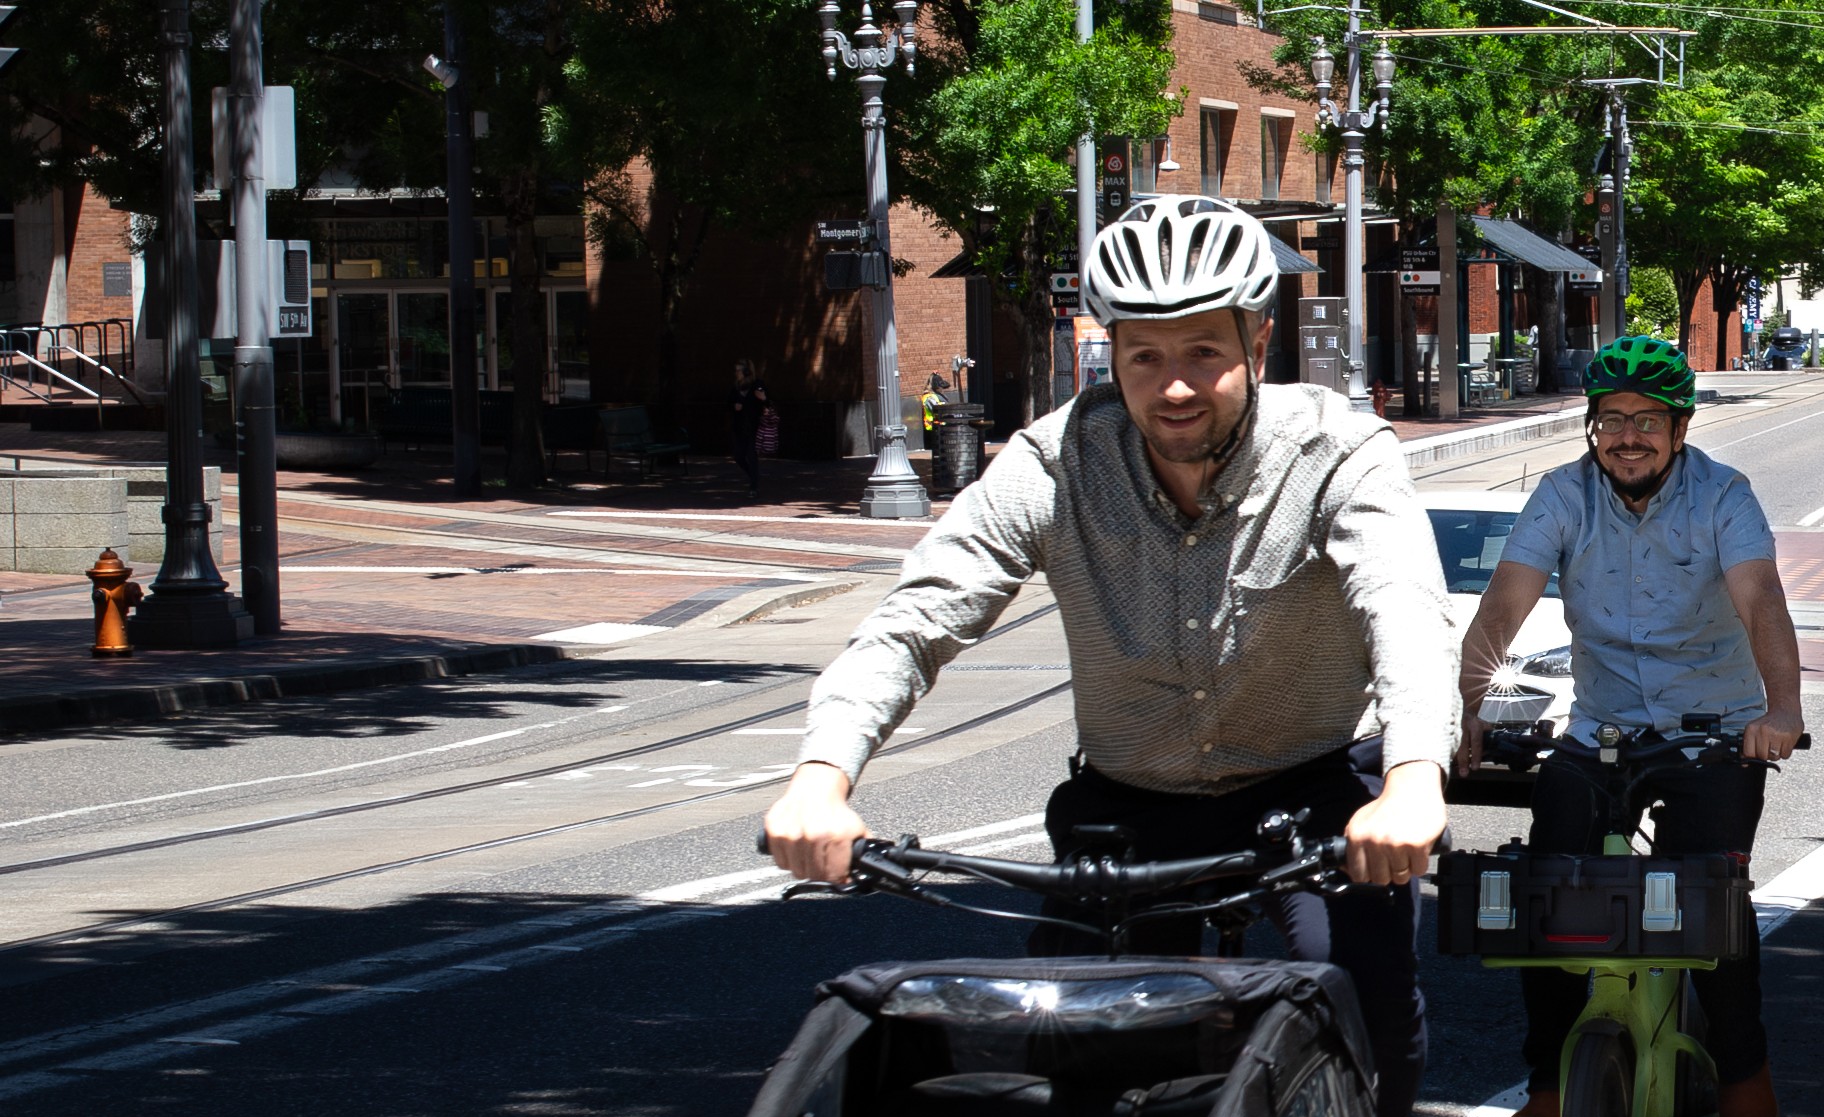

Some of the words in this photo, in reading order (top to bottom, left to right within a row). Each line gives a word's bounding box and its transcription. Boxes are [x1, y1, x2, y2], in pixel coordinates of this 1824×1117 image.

[1104, 177, 1126, 186] MAX
[820, 229, 865, 239] Montgomery
[280, 313, 289, 328] SW
[290, 312, 299, 328] 5th
